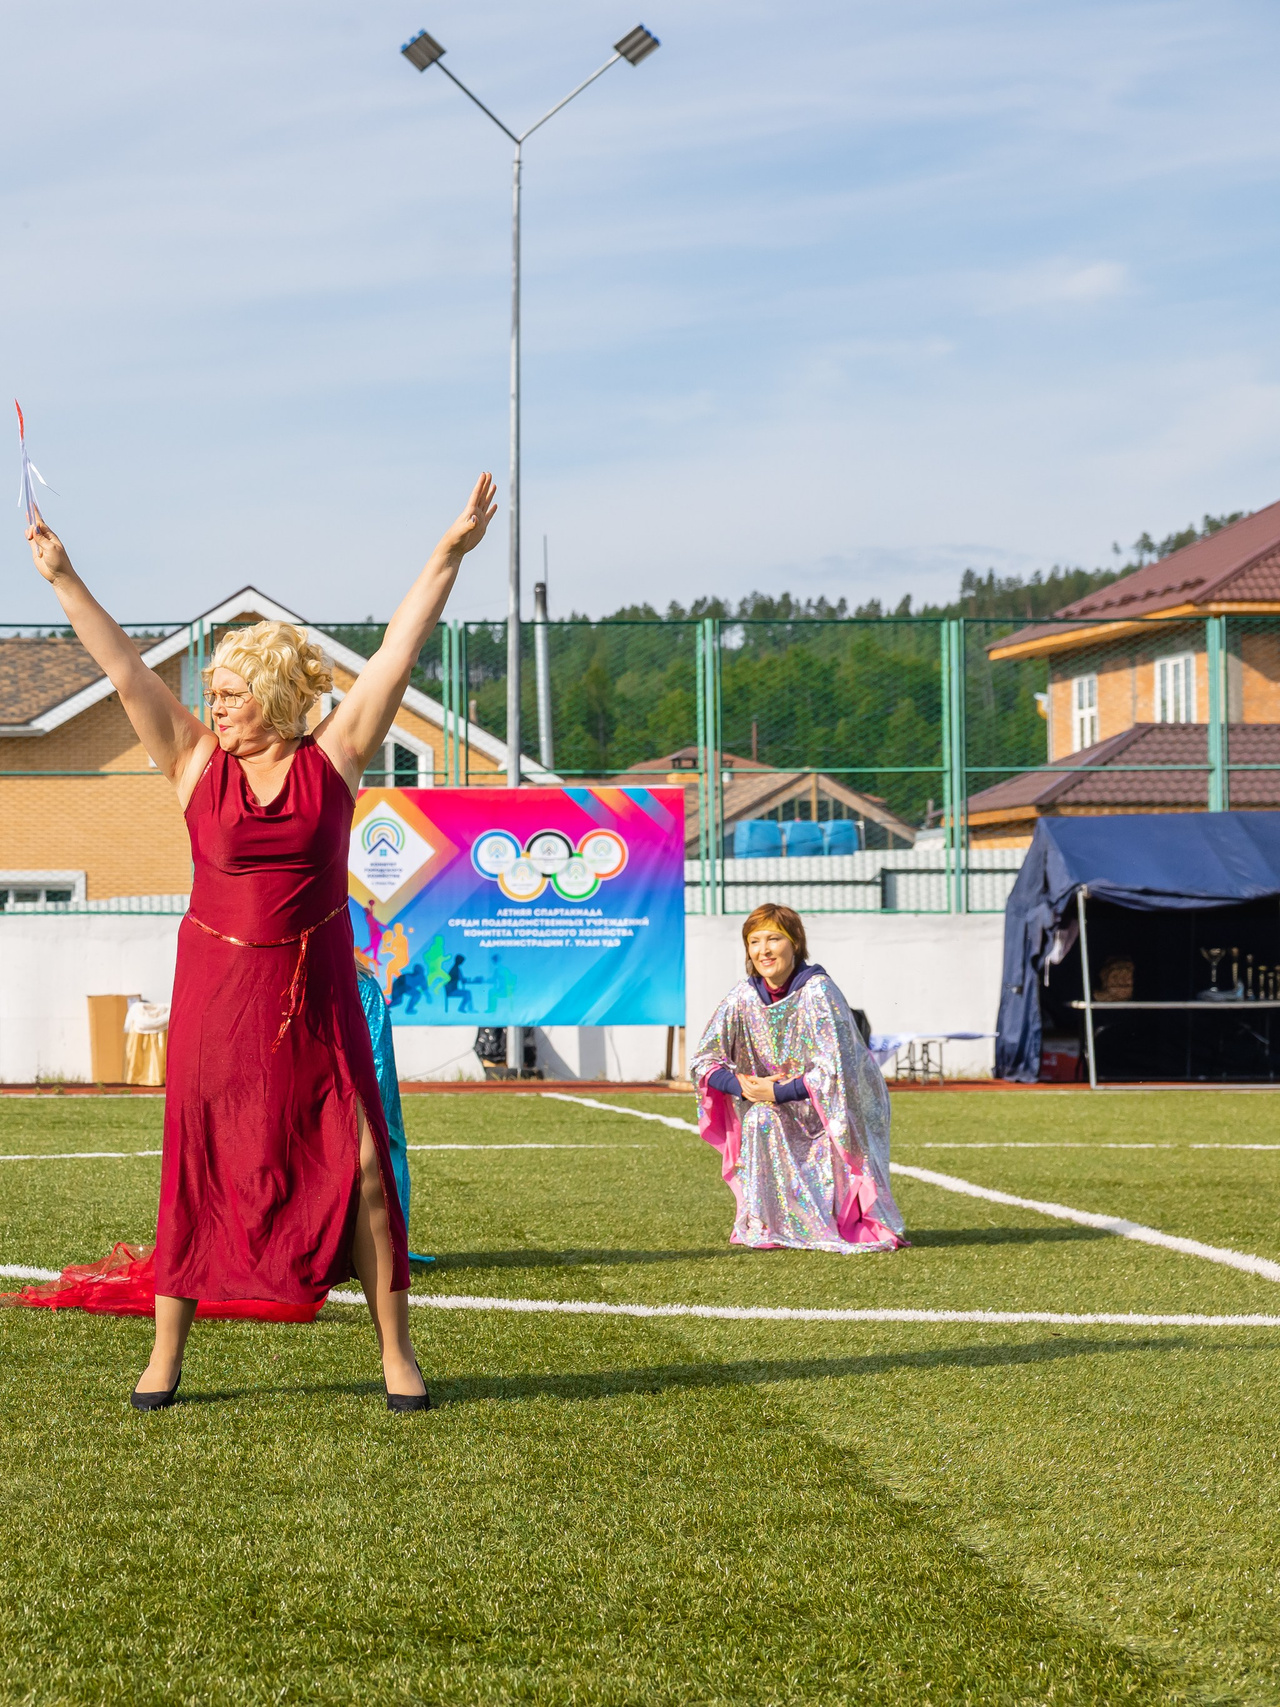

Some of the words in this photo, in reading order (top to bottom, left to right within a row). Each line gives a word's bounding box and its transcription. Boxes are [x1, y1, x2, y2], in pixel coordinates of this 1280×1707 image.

[497, 908, 532, 917] ЛЕТНЯЯ
[533, 908, 603, 917] СПАРТАКИАДА
[448, 918, 480, 927] СРЕДИ
[481, 918, 584, 927] ПОДВЕДОМСТВЕННЫХ
[585, 917, 649, 927] УЧРЕЖДЕНИЙ
[464, 929, 512, 937] КОМИТЕТА
[514, 929, 577, 937] ГОРОДСКОГО
[578, 927, 634, 937] ХОЗЯЙСТВА
[479, 939, 563, 948] АДМИНИСТРАЦИИ
[575, 939, 600, 948] УЛАН
[602, 939, 621, 948] УДЭ
